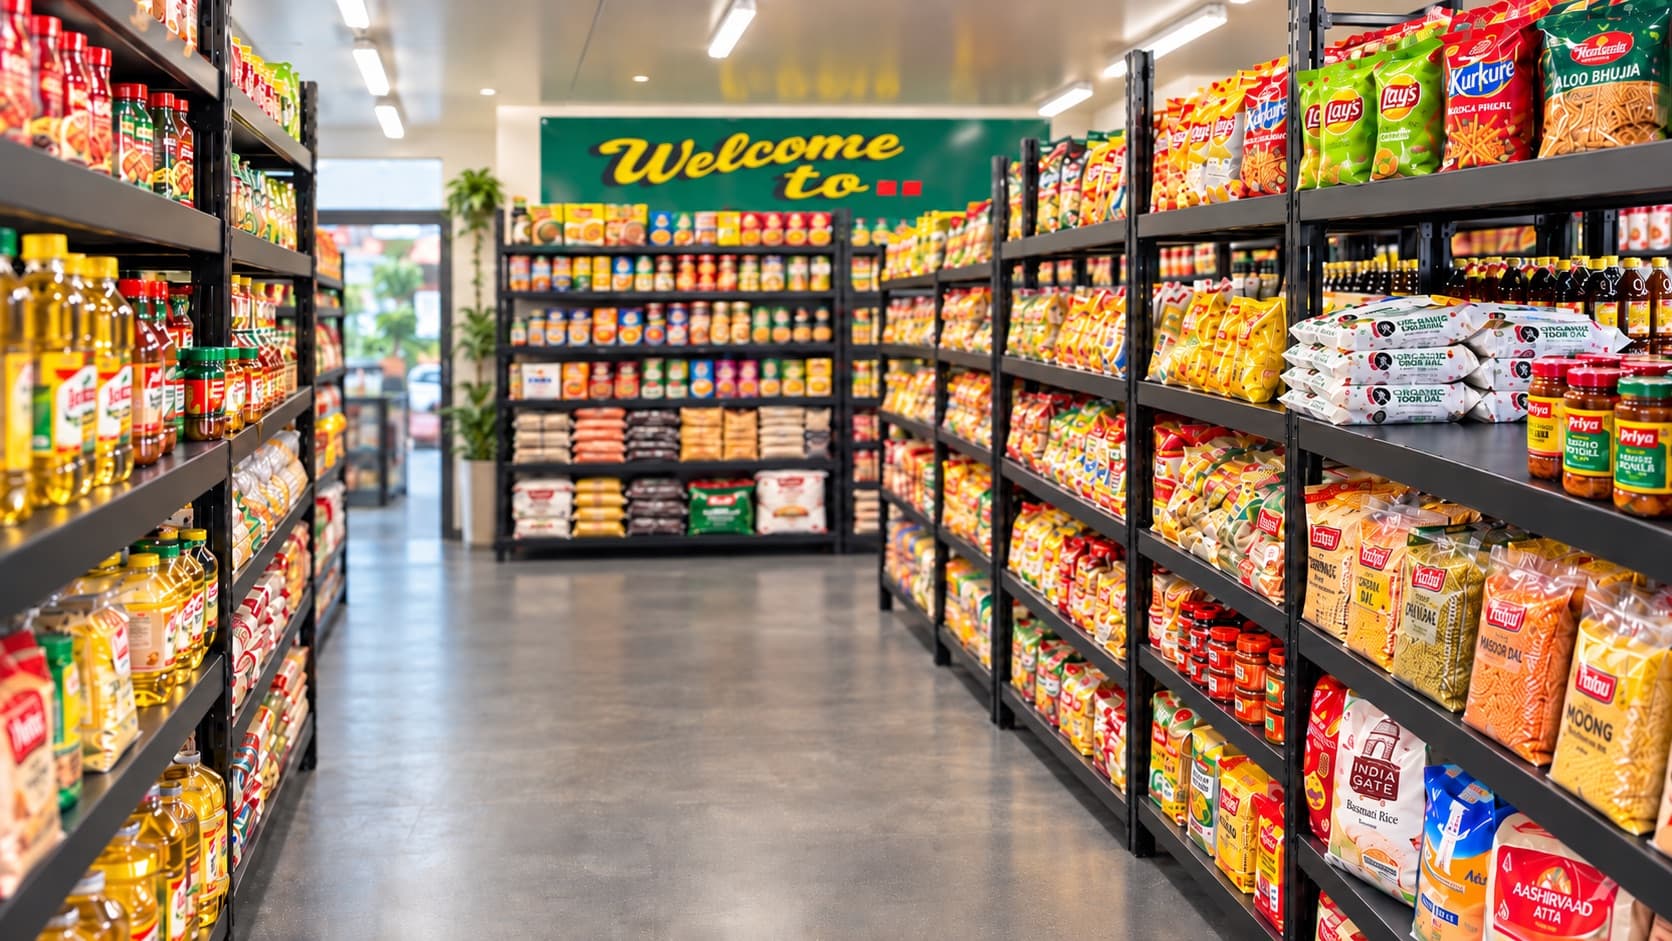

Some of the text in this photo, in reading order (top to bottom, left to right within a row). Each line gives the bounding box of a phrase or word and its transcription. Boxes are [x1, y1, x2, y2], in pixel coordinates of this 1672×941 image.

[1448, 60, 1515, 97] Kurkure
[1554, 62, 1641, 88] ALOO BHUJIA
[1382, 84, 1417, 110] Lay's
[1325, 99, 1360, 124] Lay's
[597, 131, 905, 185] Welcome
[782, 162, 870, 201] to
[1568, 416, 1600, 431] Priya
[1620, 429, 1655, 446] Priya
[1567, 703, 1614, 743] MOONG
[1352, 774, 1393, 796] GATE
[1354, 762, 1396, 783] INDIA
[1346, 799, 1377, 819] Basmati
[1378, 810, 1399, 825] Rice
[1512, 881, 1594, 917] AASHIRVAAD
[1532, 905, 1562, 925] ATTA
